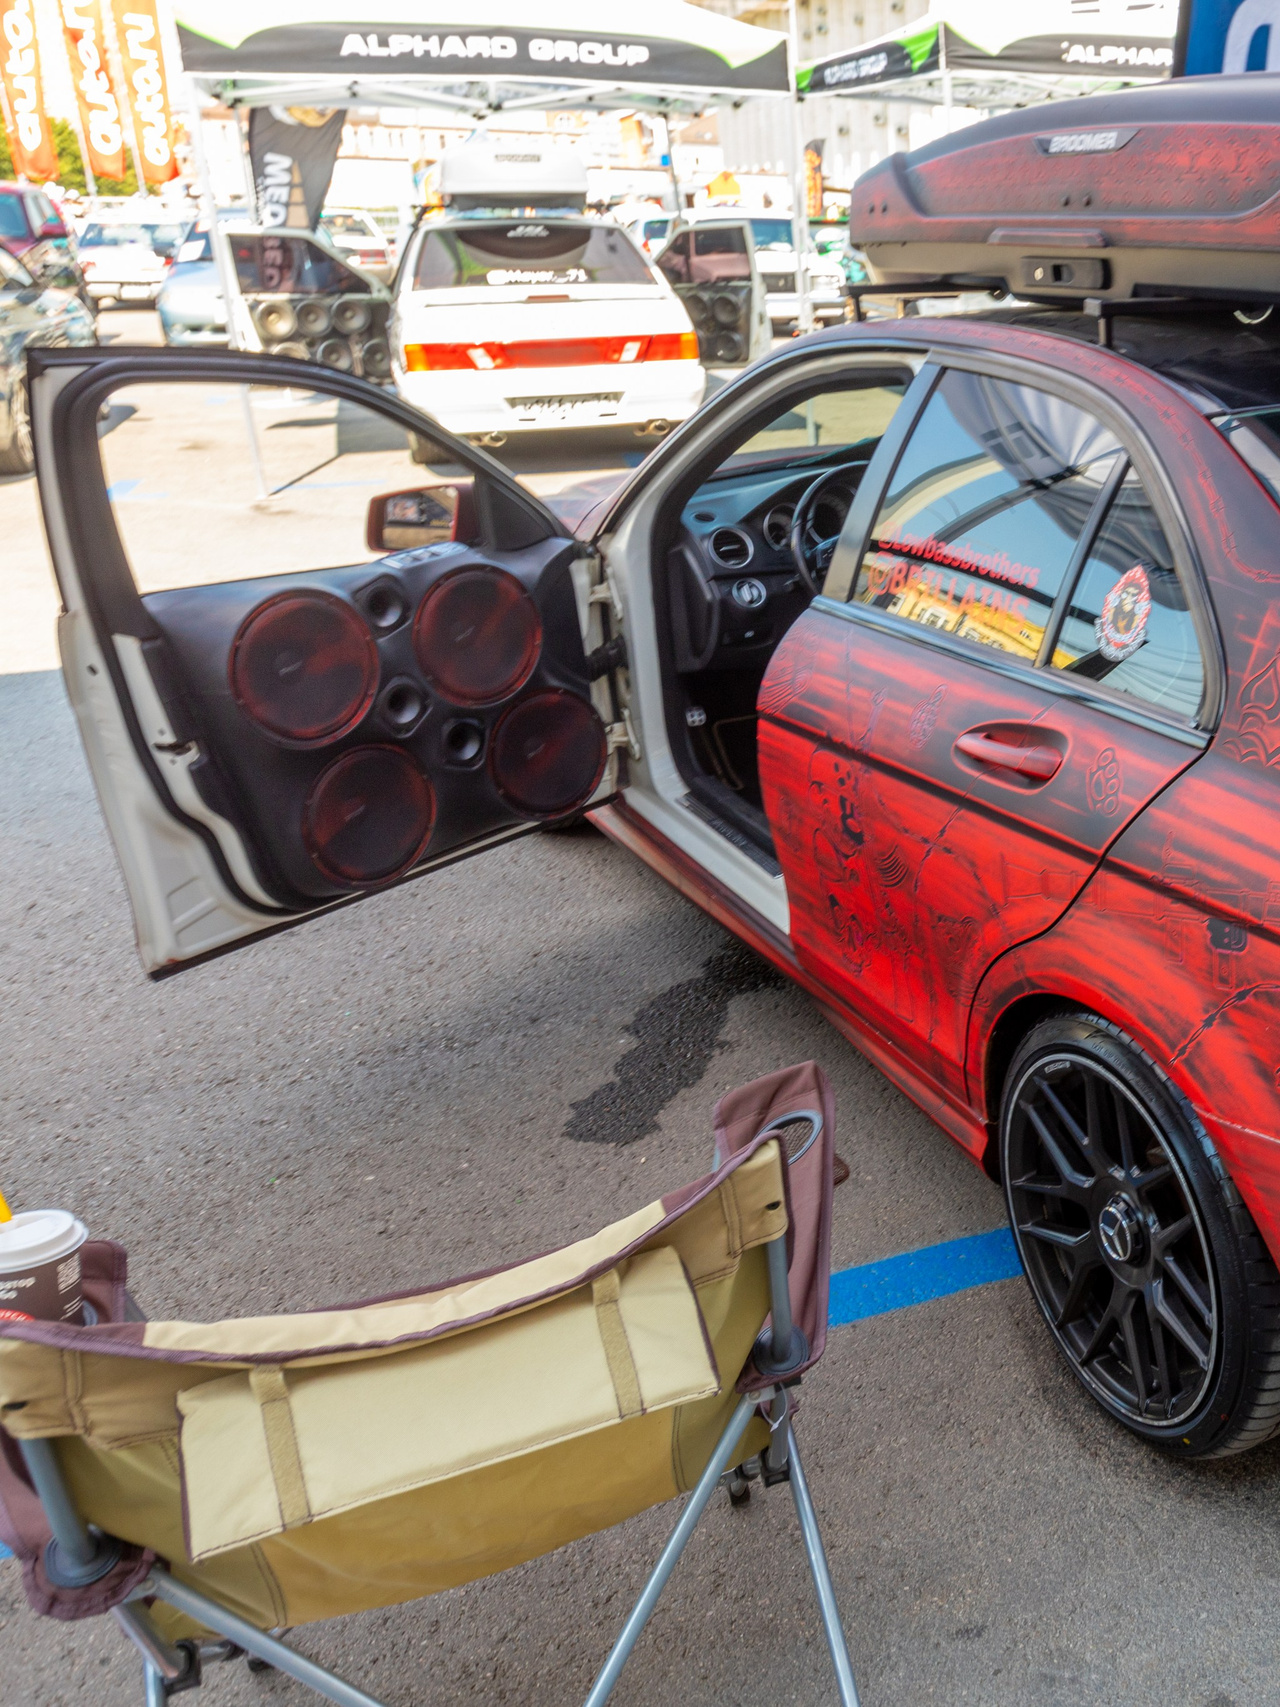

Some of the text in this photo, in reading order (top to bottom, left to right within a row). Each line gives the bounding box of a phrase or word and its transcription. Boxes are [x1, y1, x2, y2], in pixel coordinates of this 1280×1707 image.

[340, 34, 649, 66] ALPHARD GROUP
[123, 12, 170, 166] auto.ru
[1048, 131, 1119, 154] BROOMER
